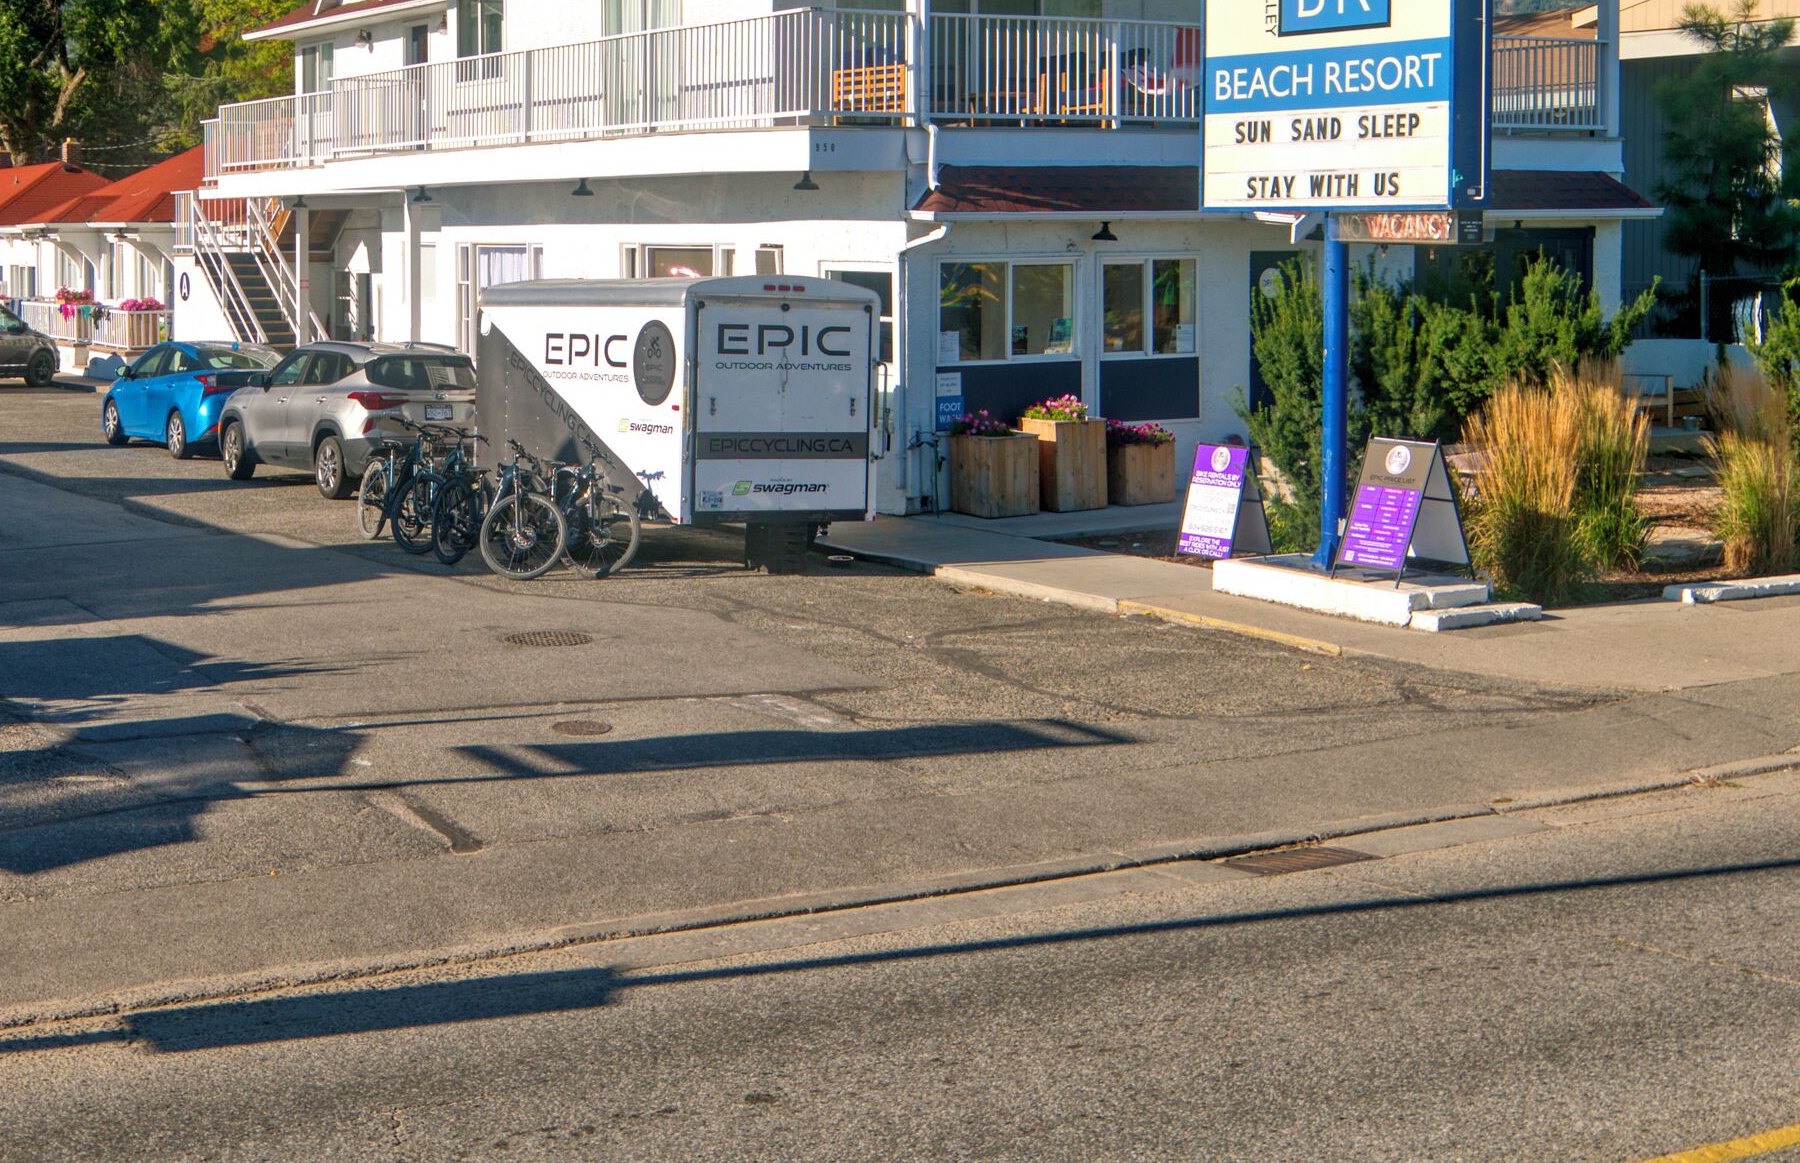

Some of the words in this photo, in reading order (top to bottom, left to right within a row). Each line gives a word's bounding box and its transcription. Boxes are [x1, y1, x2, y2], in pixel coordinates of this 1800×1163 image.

[1215, 64, 1313, 101] BEACH
[1325, 53, 1442, 94] RESORT
[1235, 120, 1272, 144] SUN
[1291, 117, 1341, 141] SAND
[1358, 113, 1420, 138] SLEEP
[1247, 176, 1295, 199] STAY
[1310, 174, 1358, 197] WITH
[1374, 173, 1399, 196] US
[1365, 212, 1451, 239] VACANCY
[718, 323, 852, 357] EPIC
[545, 333, 628, 368] EPIC
[542, 370, 577, 380] OUTDOOR
[578, 372, 630, 383] ADVENTURES
[715, 362, 774, 370] OUTDOOR
[776, 363, 853, 372] ADVENTURES
[939, 402, 962, 413] FOOT
[629, 422, 674, 435] swagman
[709, 438, 854, 453] EPICCYCLING.CA
[753, 483, 826, 496] swagman
